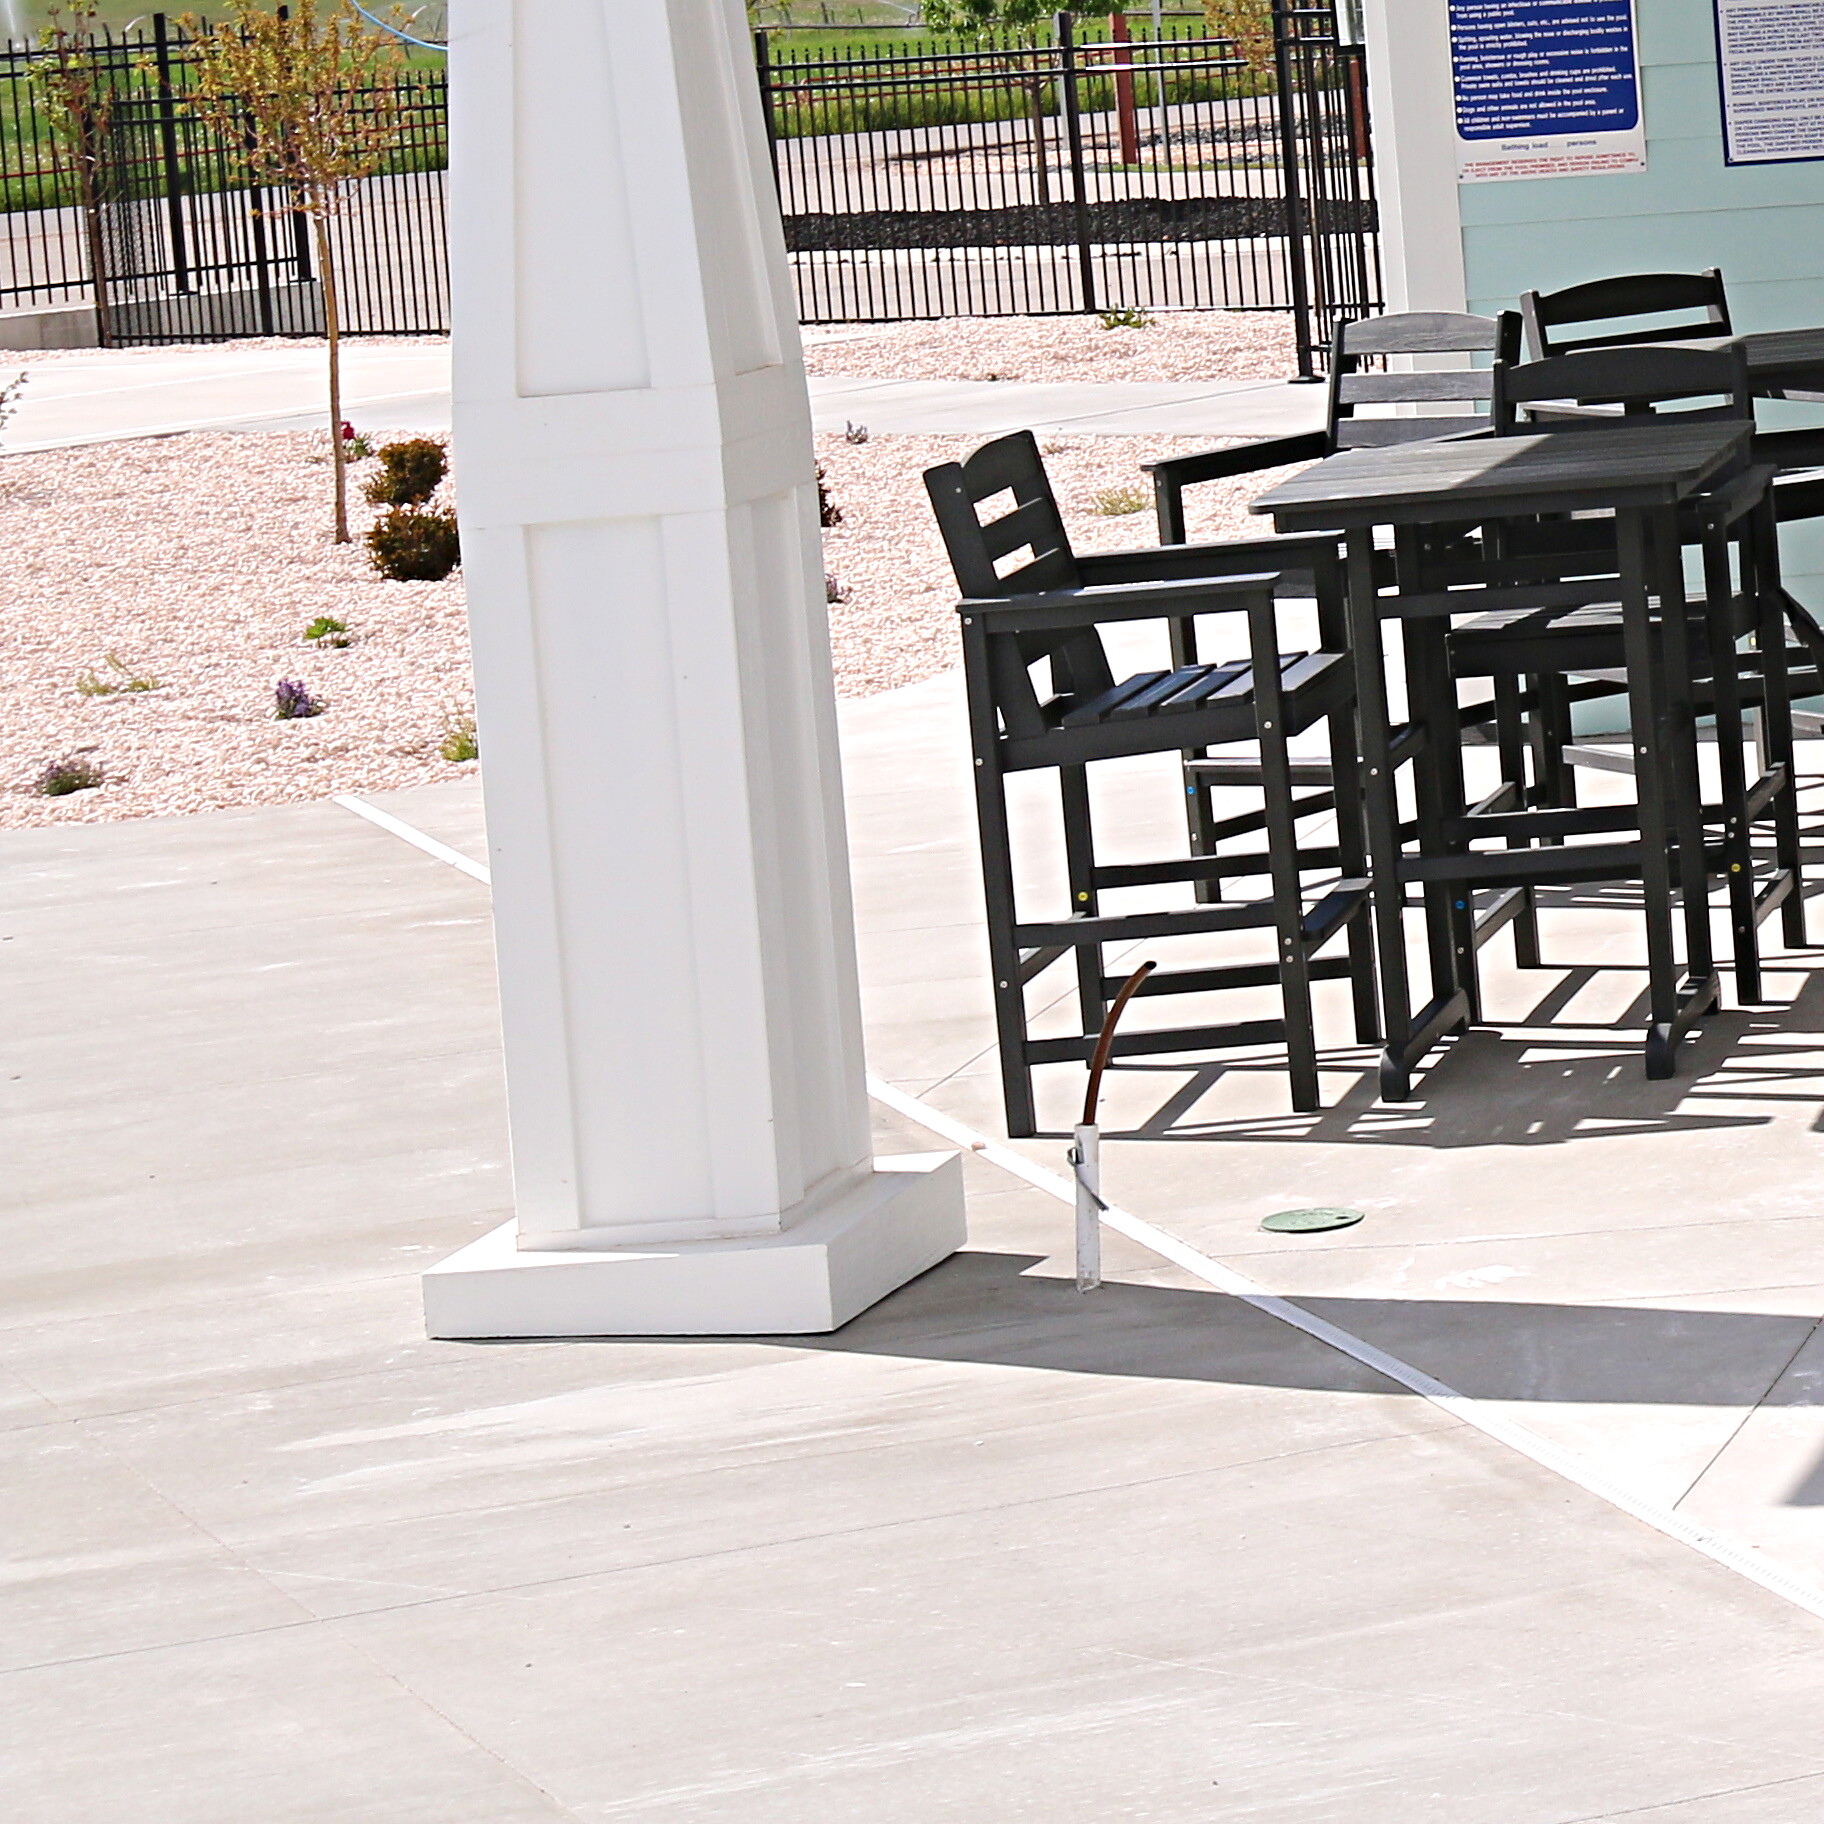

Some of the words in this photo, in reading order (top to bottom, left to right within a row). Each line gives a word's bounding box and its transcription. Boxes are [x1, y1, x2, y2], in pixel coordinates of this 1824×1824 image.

[1501, 142, 1530, 152] Bathing
[1531, 141, 1548, 149] load
[1566, 139, 1597, 147] persons
